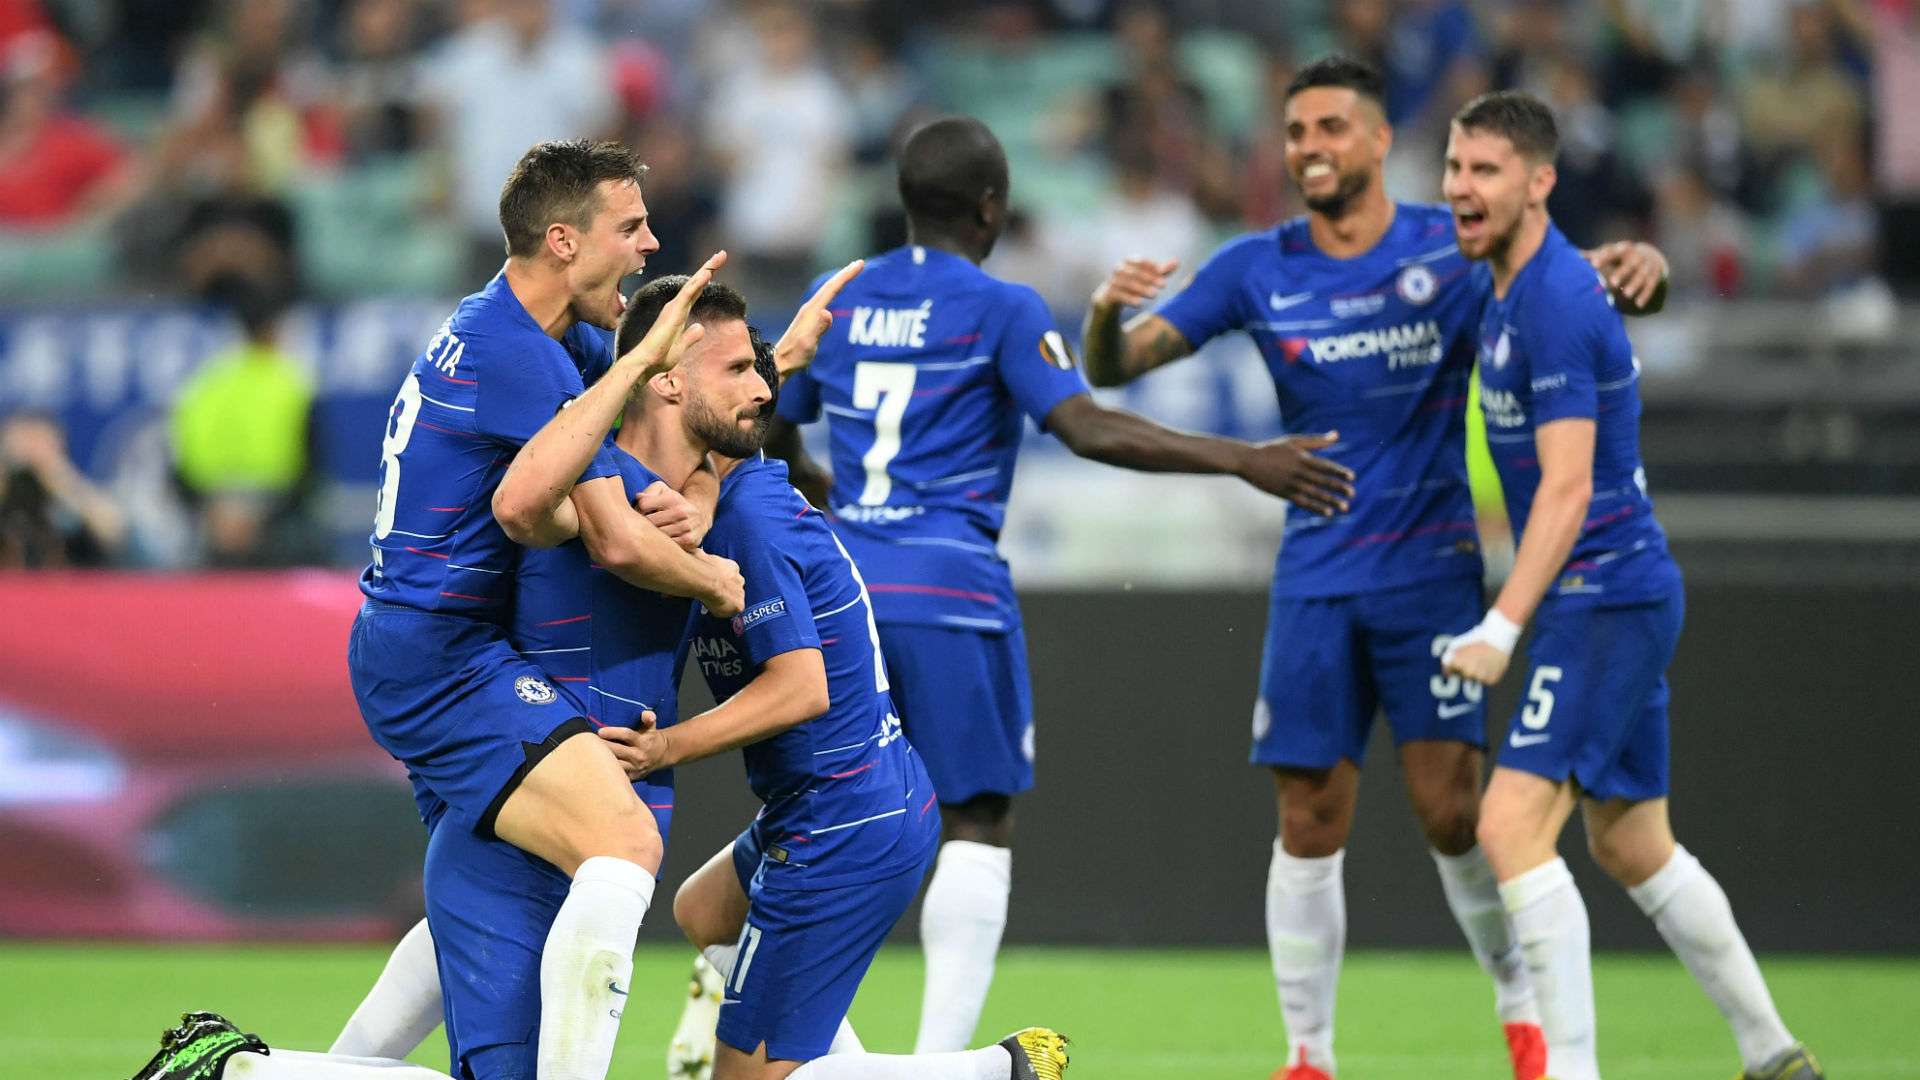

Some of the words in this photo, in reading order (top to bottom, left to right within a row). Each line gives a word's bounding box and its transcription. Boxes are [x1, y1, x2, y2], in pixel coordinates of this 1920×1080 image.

[848, 299, 933, 348] KANTÉ
[1308, 321, 1441, 364] YOKOHAMA
[853, 361, 917, 506] 7
[743, 600, 785, 625] RESPECT
[702, 658, 743, 677] TYES
[1521, 665, 1563, 730] 5
